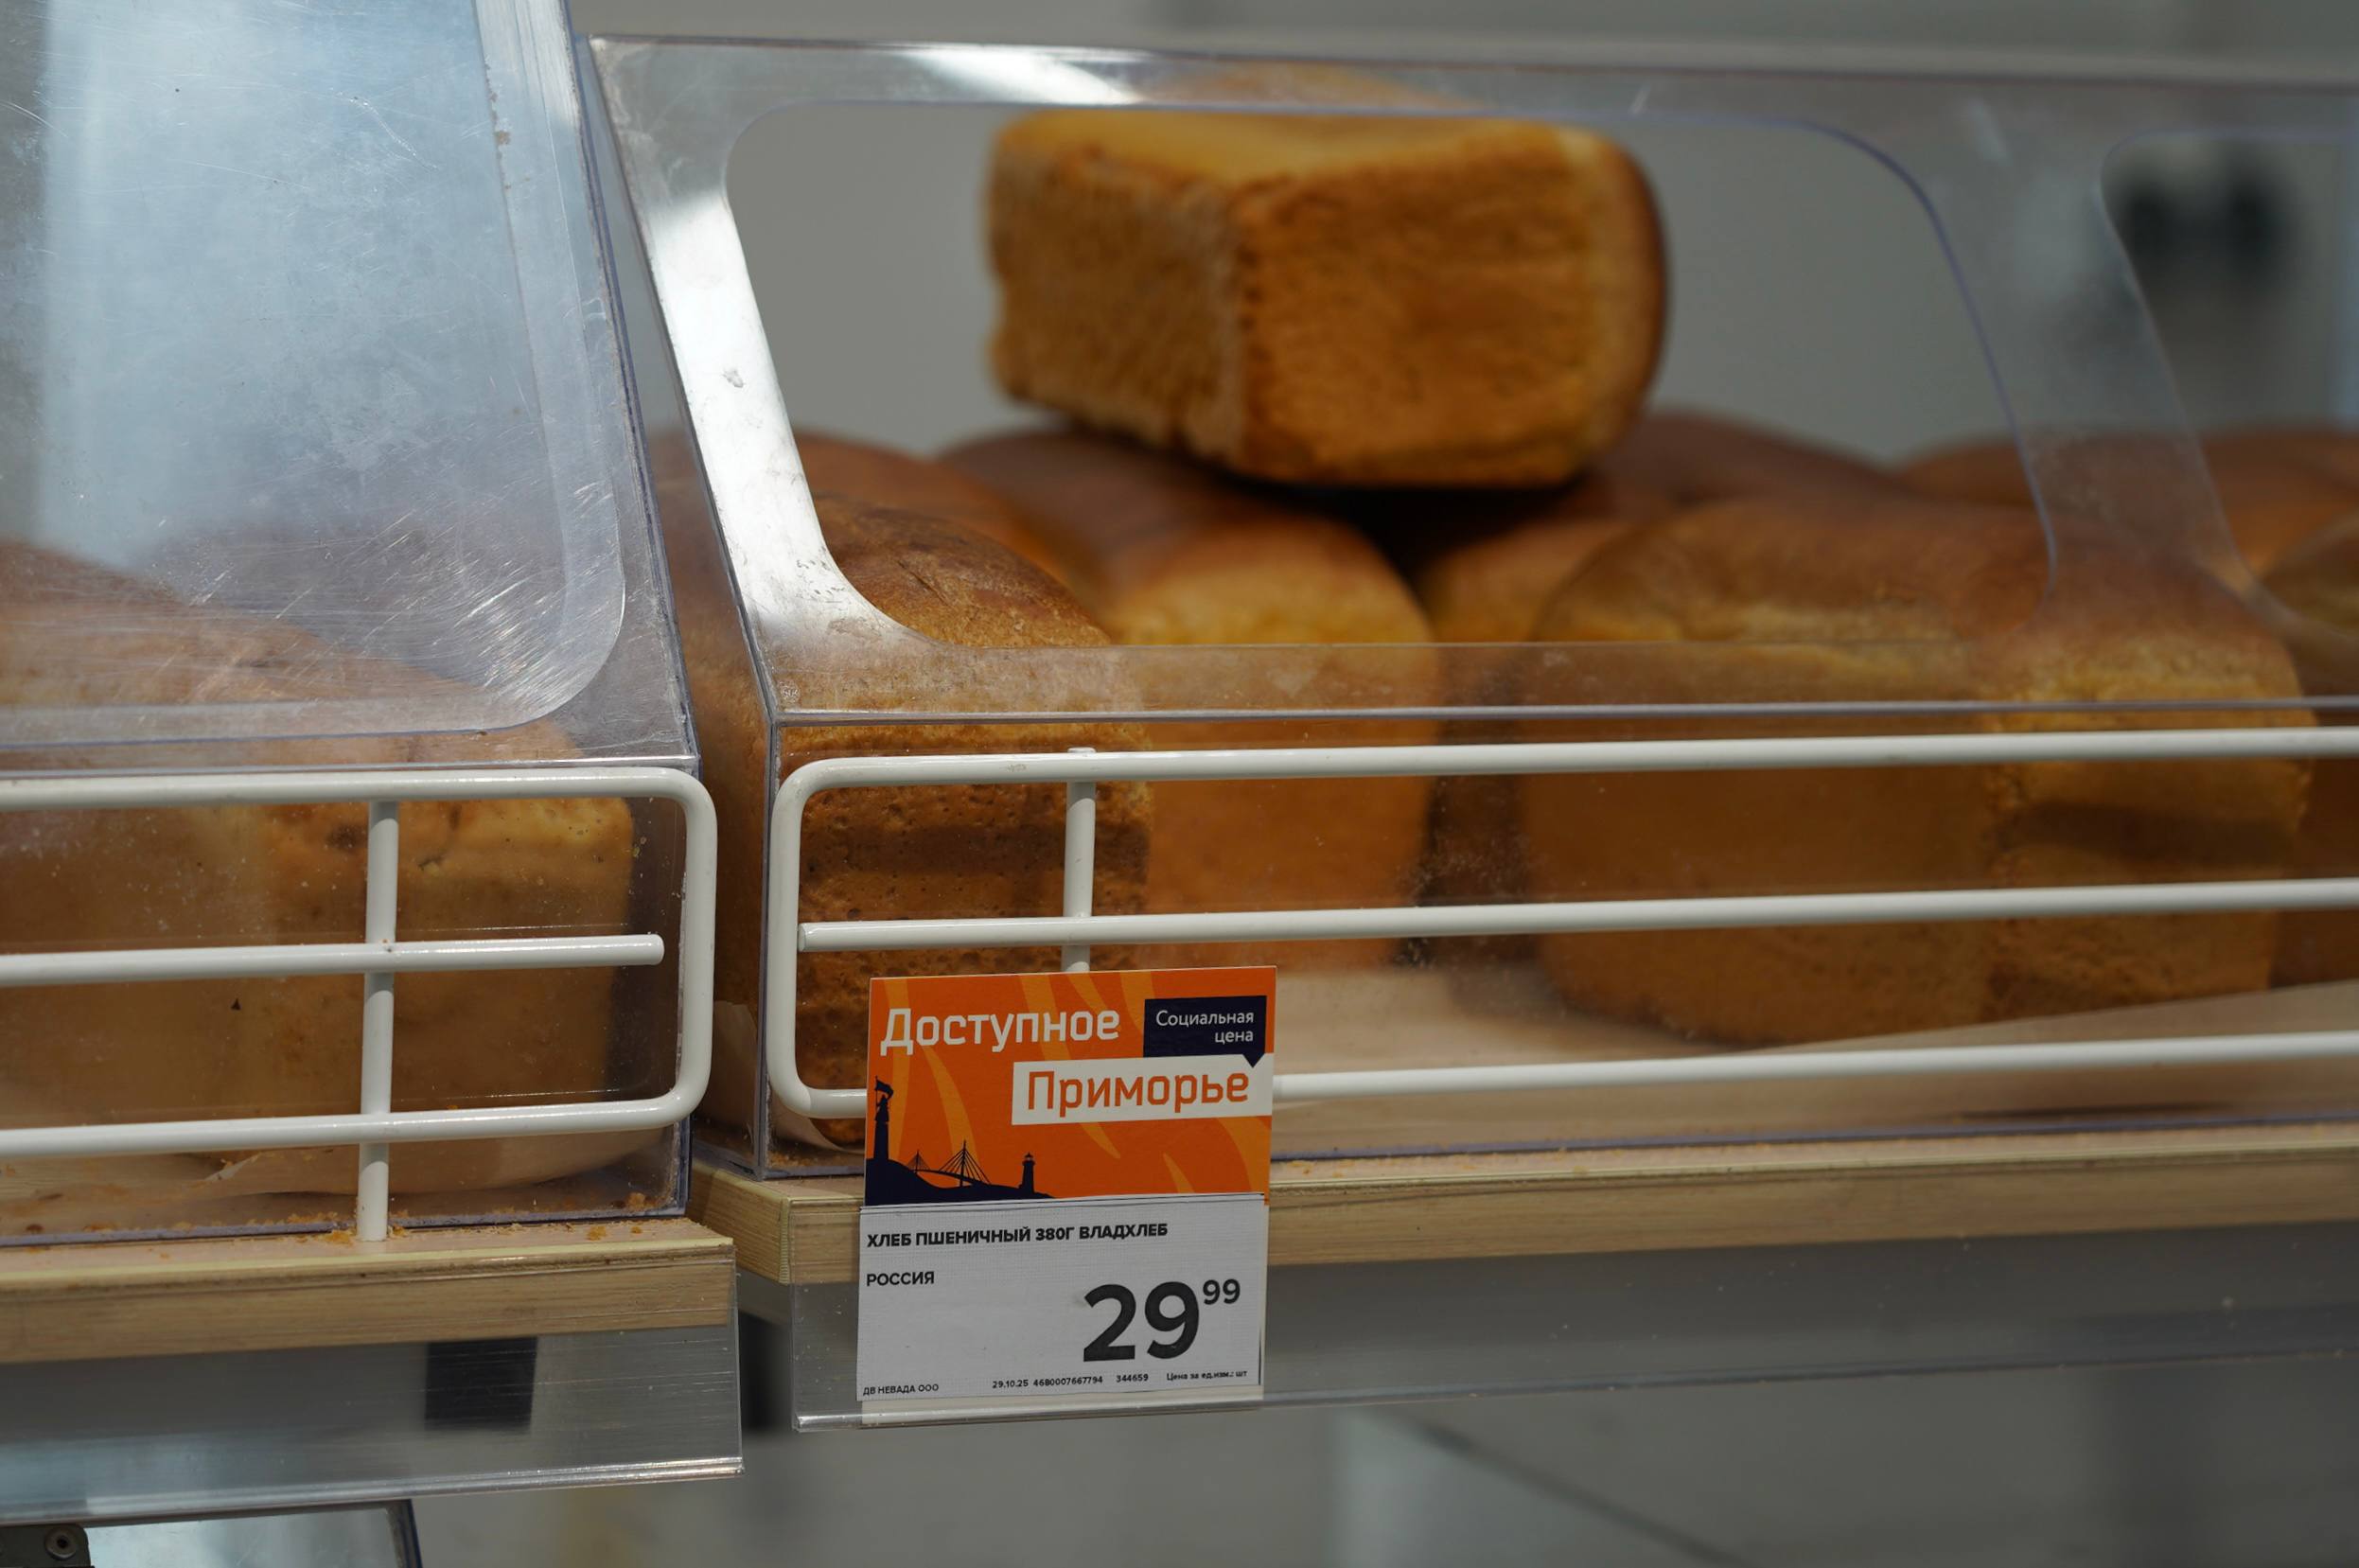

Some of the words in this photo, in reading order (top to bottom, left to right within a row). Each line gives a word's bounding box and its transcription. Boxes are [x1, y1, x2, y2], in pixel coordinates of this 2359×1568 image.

[1155, 1009, 1255, 1029] Социальная
[880, 1008, 1120, 1056] Доступное
[1214, 1028, 1255, 1046] цена
[1028, 1070, 1250, 1118] Приморье
[867, 1233, 912, 1248] ХЛЕБ
[915, 1226, 1031, 1246] ПШЕНИЧНЫЙ
[1035, 1226, 1075, 1242] 380Г
[1079, 1223, 1169, 1241] ВЛАДХЛЕБ
[866, 1271, 935, 1287] РОССИЯ
[1083, 1280, 1200, 1363] 29
[1202, 1278, 1241, 1306] 99
[863, 1386, 876, 1396] ДВ
[878, 1384, 916, 1395] НЕВАДА
[918, 1383, 940, 1392] ООО
[993, 1379, 1029, 1389] 29.10.25
[1033, 1376, 1103, 1387] 4680007667794
[1116, 1373, 1150, 1383] 344659
[1166, 1372, 1188, 1382] Цена
